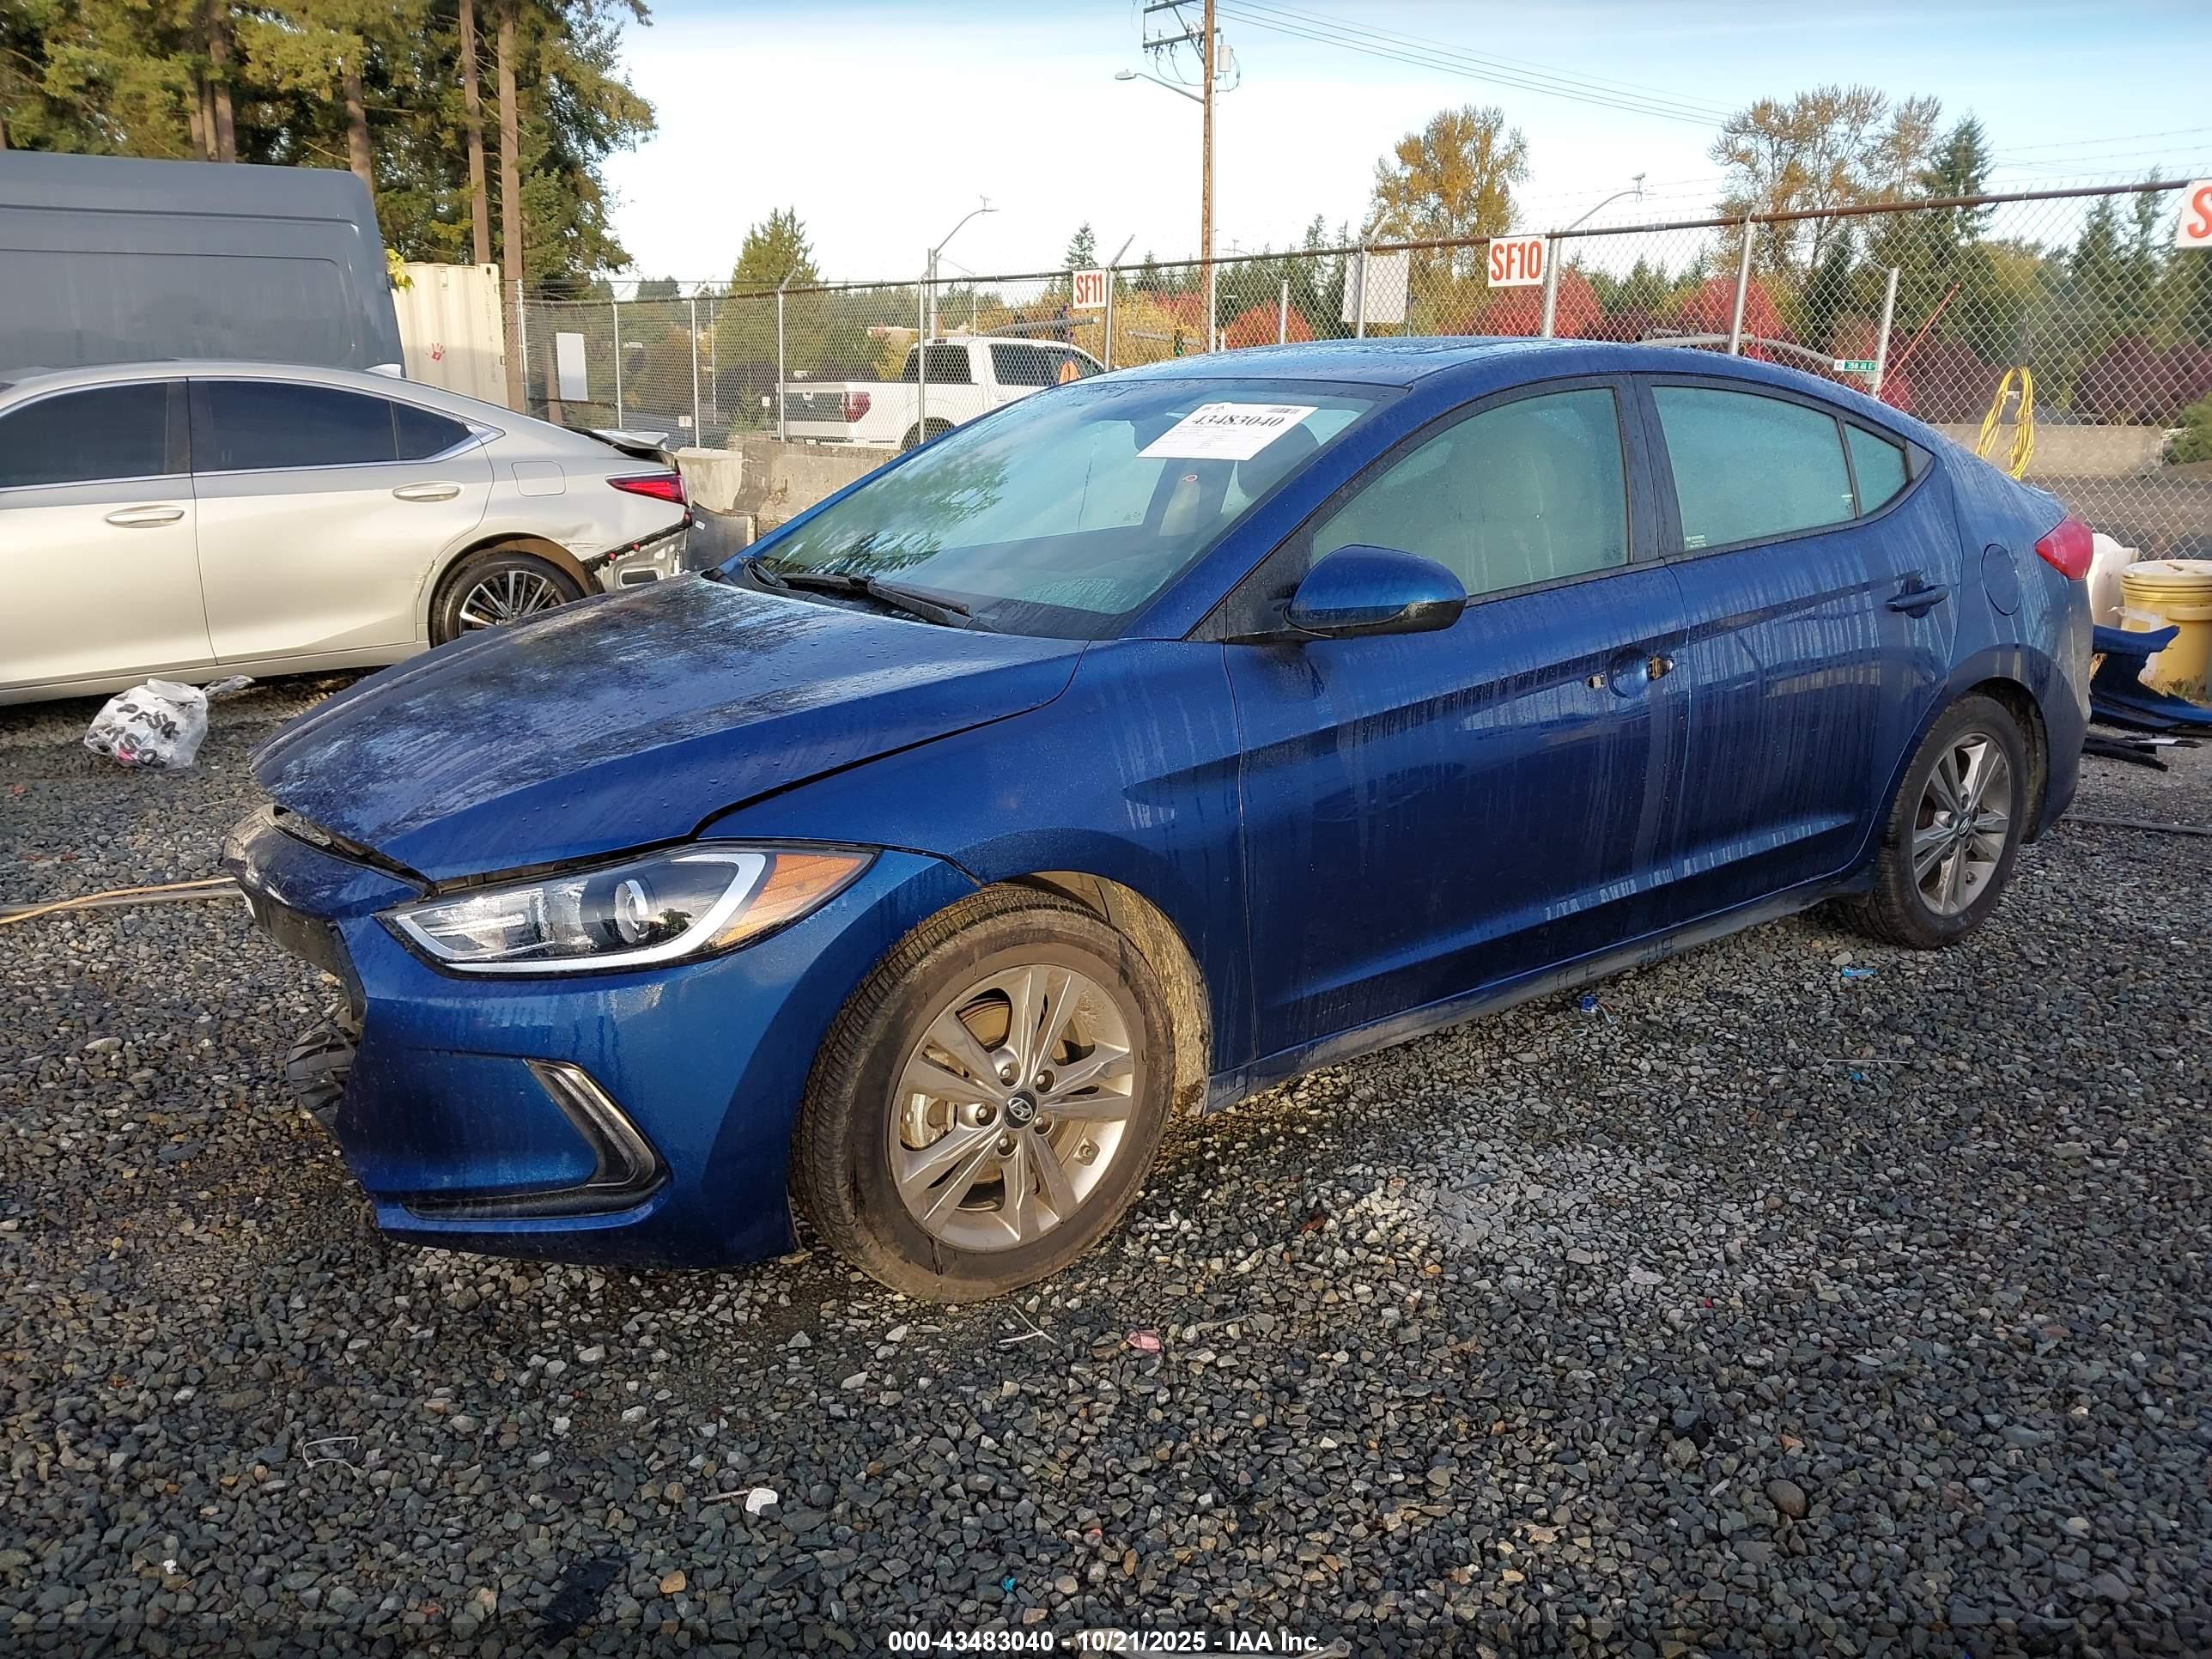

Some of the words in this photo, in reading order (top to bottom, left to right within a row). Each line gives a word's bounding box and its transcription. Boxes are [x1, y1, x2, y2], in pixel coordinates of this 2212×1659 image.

[1491, 241, 1542, 282] SF10
[1076, 273, 1103, 305] SF11
[1191, 414, 1285, 428] 43483040
